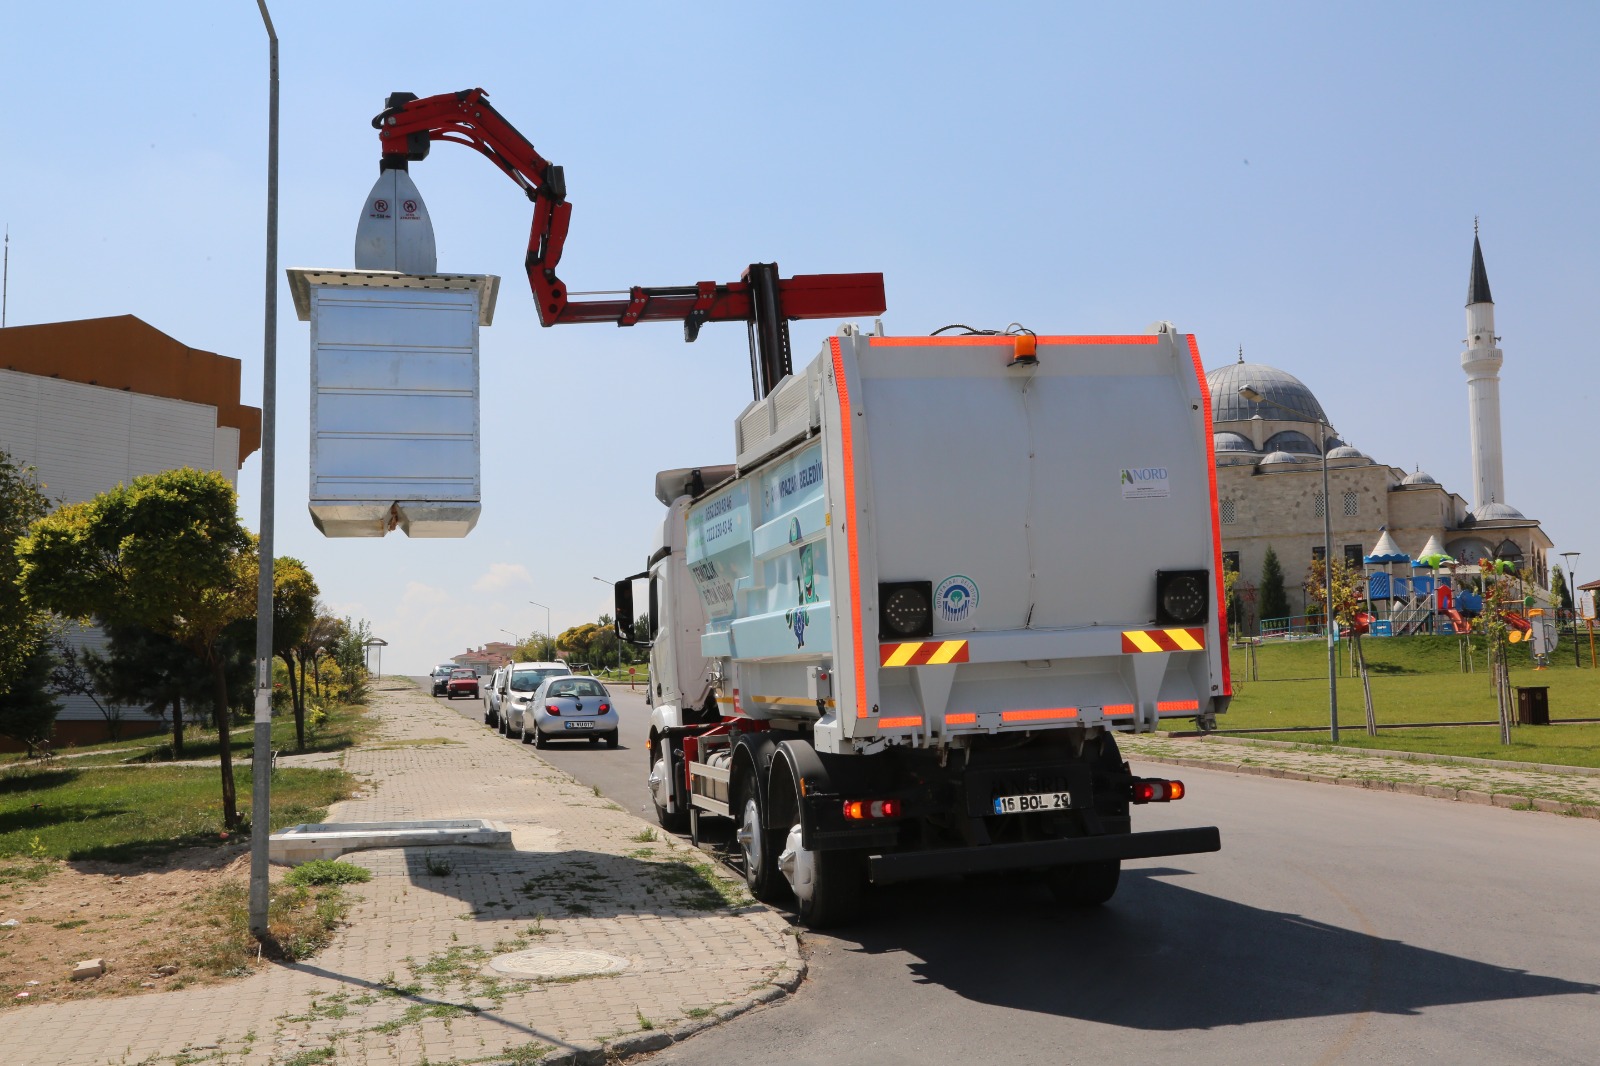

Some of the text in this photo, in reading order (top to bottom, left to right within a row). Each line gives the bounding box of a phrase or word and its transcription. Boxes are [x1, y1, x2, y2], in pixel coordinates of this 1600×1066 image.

[1132, 468, 1168, 481] NORD
[1001, 797, 1015, 812] 16
[1019, 795, 1048, 811] BOL
